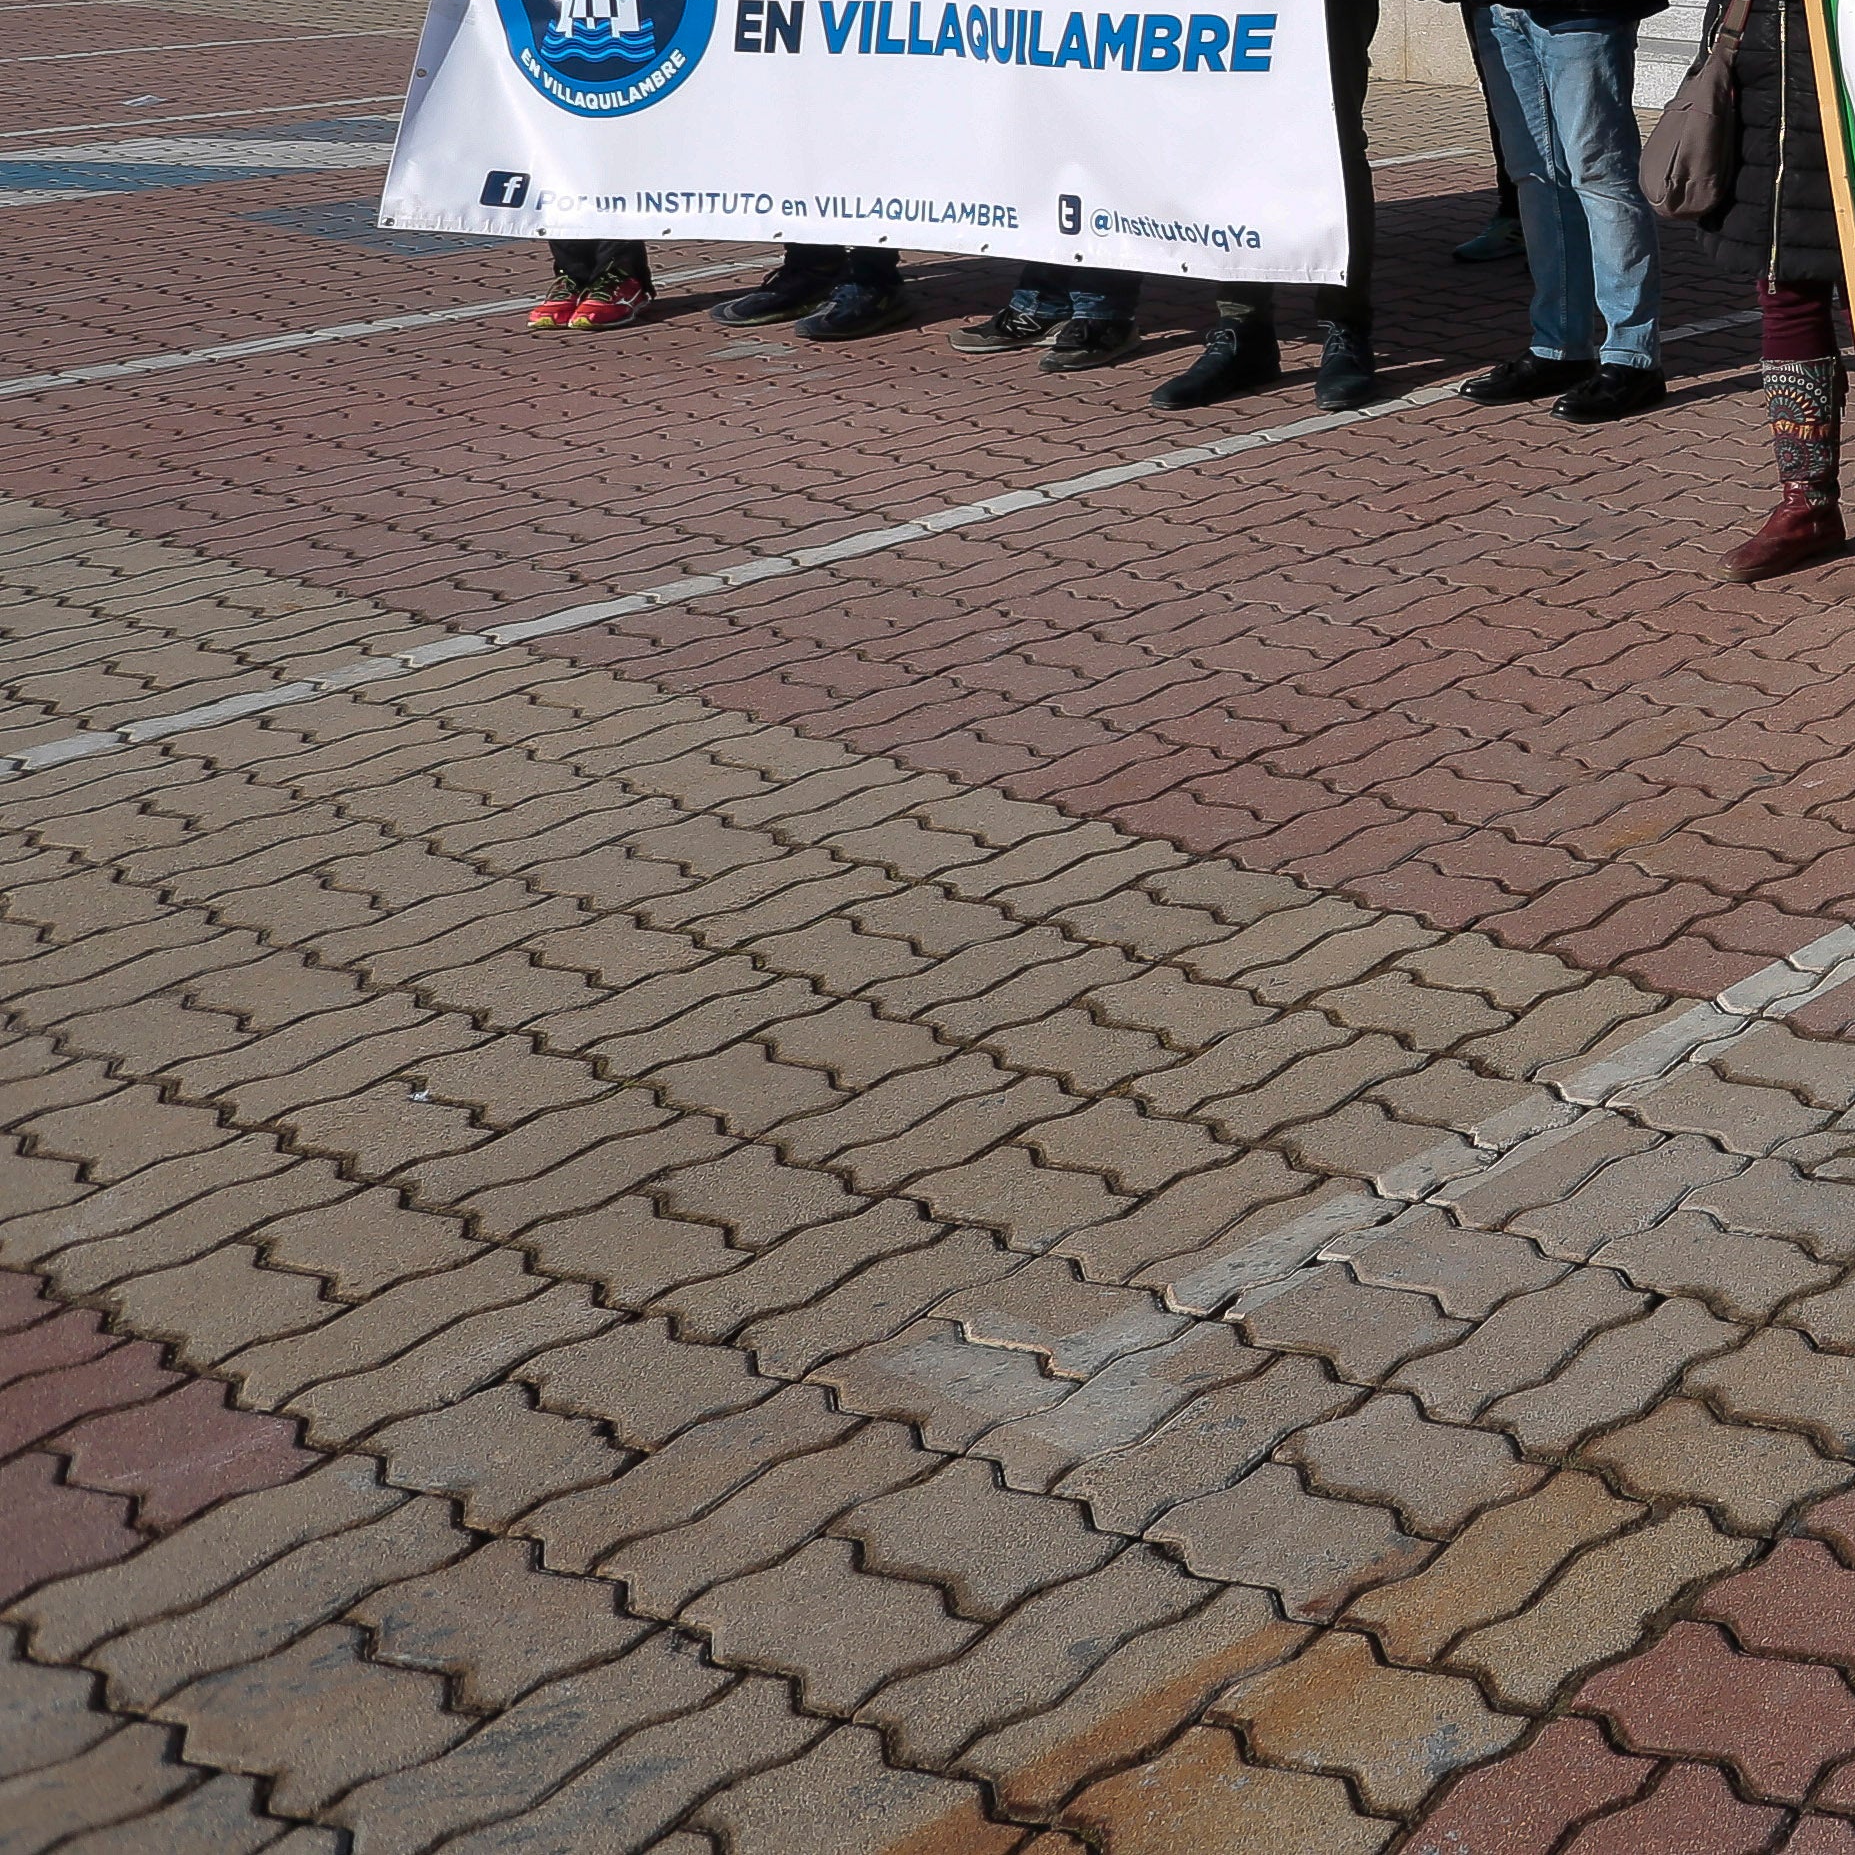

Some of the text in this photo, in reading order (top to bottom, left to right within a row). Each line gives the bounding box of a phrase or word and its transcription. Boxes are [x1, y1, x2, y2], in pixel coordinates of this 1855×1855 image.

[734, 0, 1278, 73] EN VILLAQUILAMBRE
[520, 47, 688, 111] EN VILLAQUILAMBRE
[535, 190, 587, 212] Por
[596, 195, 626, 213] un
[636, 191, 774, 215] INSTITUTO
[781, 199, 807, 218] en
[814, 195, 1020, 229] VILLAQUILAMBRE
[1090, 208, 1261, 253] @InstitutoVqYa
